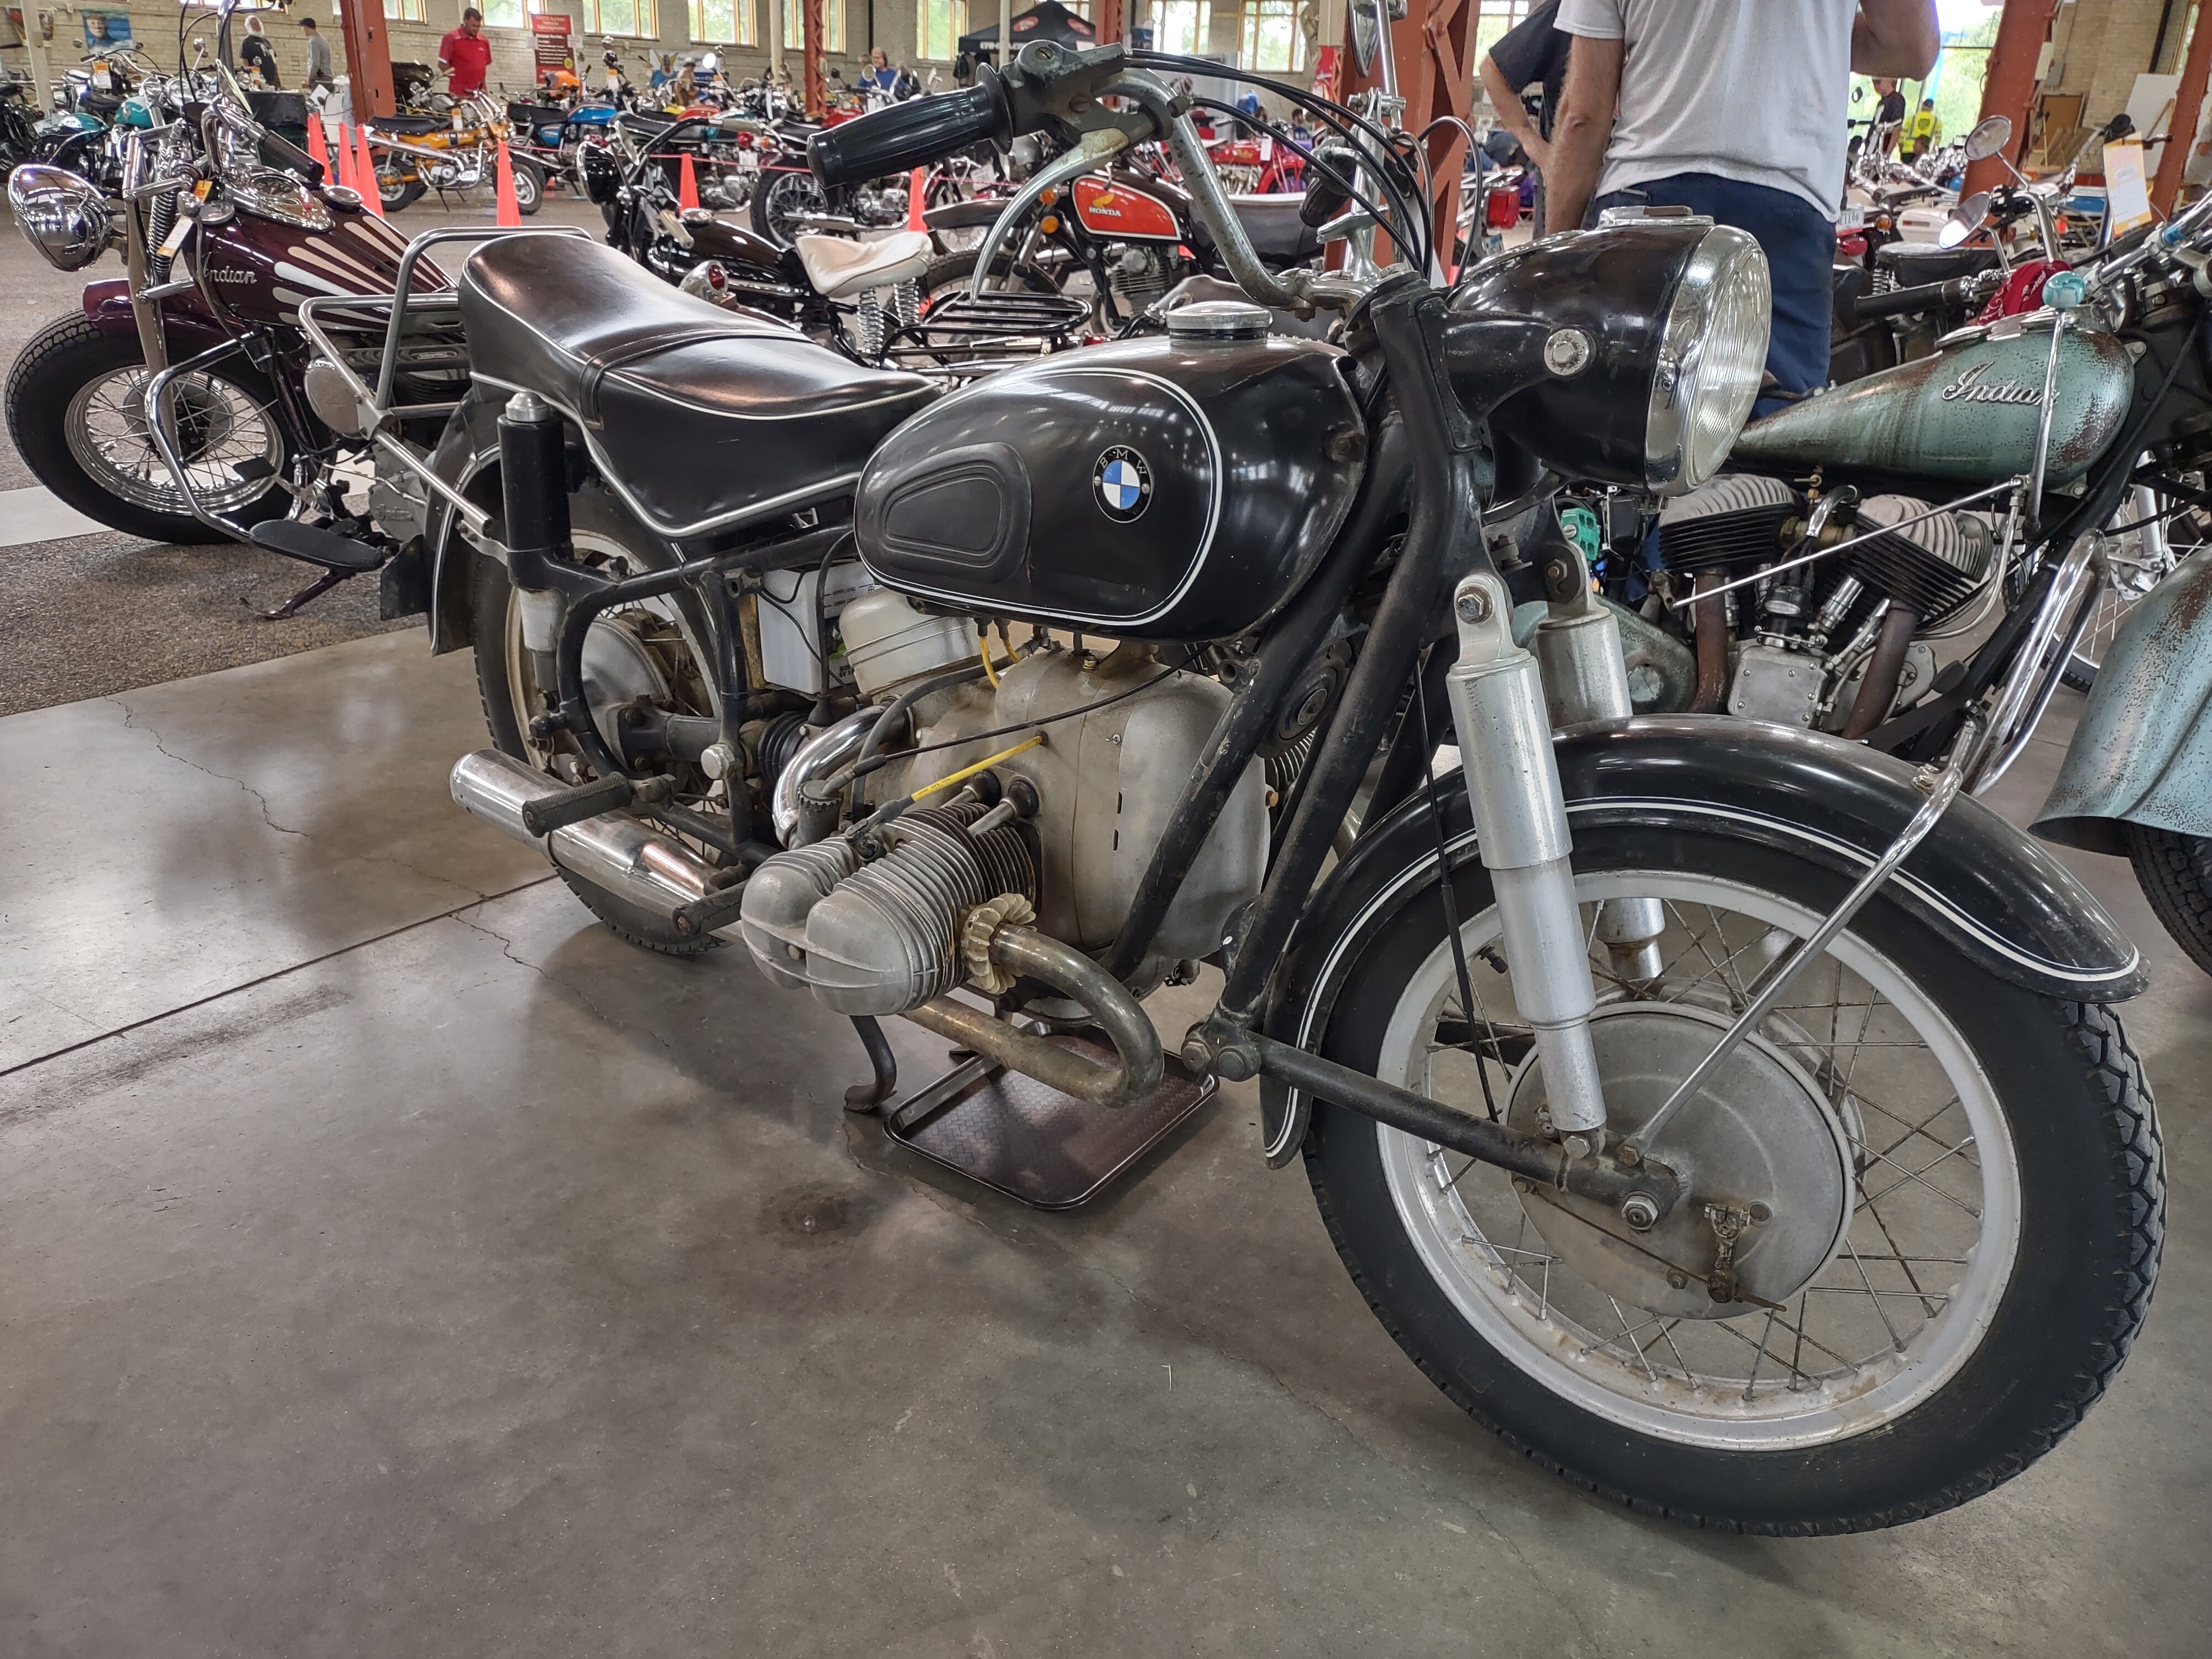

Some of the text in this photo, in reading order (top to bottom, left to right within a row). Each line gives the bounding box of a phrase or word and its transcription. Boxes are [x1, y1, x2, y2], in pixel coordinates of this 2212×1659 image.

[1089, 207, 1122, 217] HONDA
[202, 251, 257, 284] Indian
[1099, 448, 1147, 474] BMW
